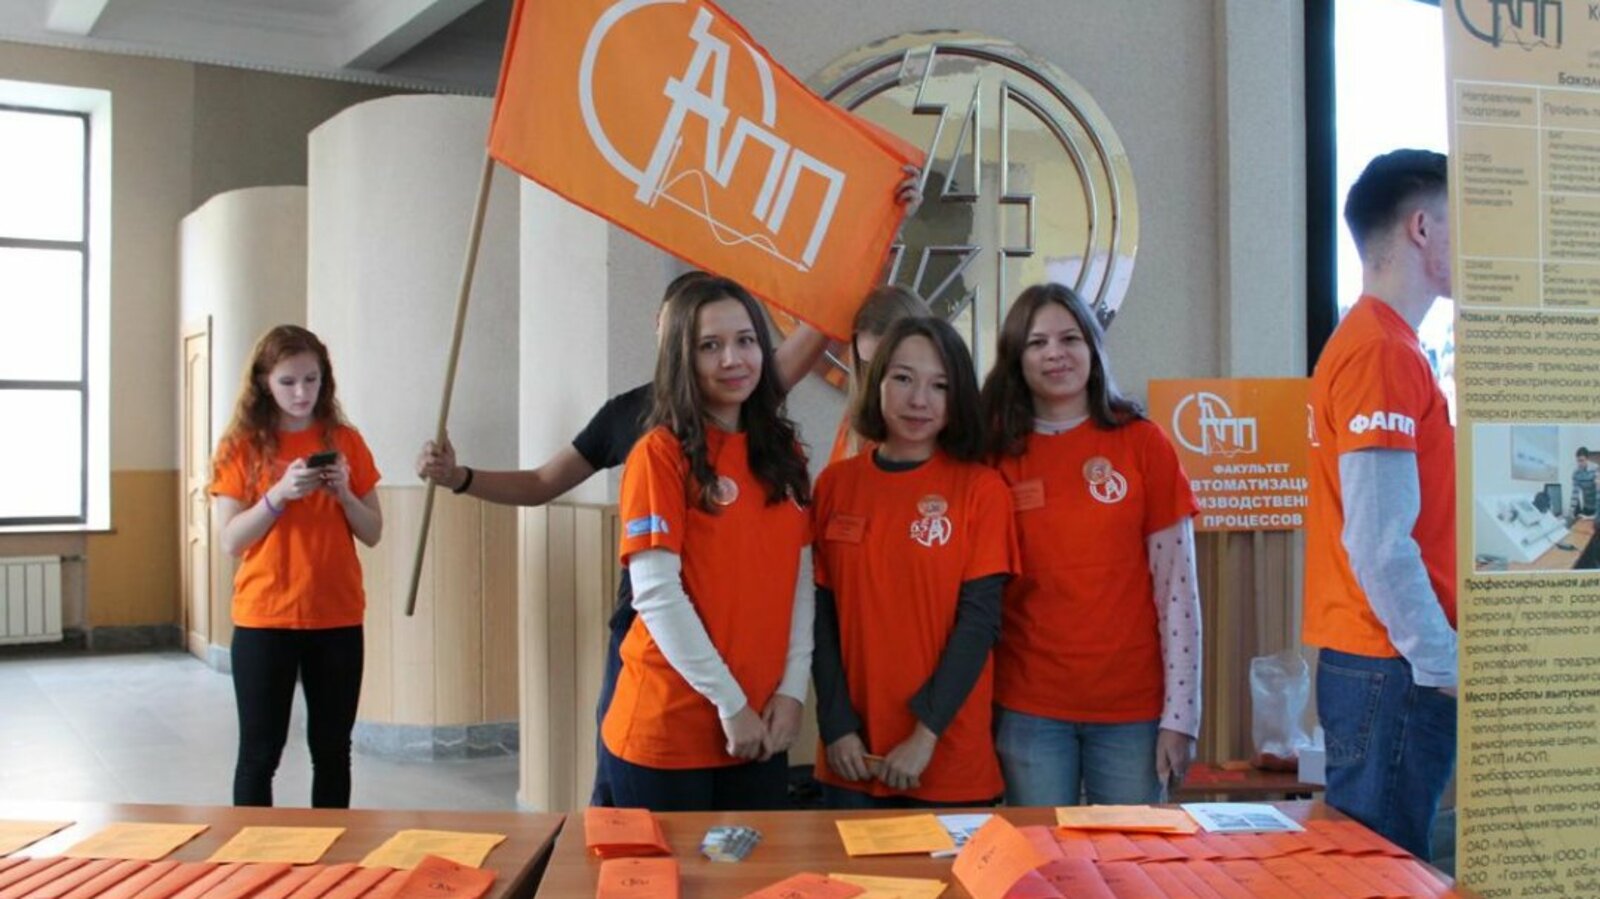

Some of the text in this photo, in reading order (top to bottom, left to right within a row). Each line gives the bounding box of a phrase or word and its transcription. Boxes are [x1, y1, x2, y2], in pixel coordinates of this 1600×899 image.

[1348, 411, 1416, 438] ФАПП
[1212, 463, 1290, 474] ФАКУЛЬТЕТ
[1203, 513, 1303, 528] ПРОЦЕССОВ
[1499, 688, 1543, 702] работы
